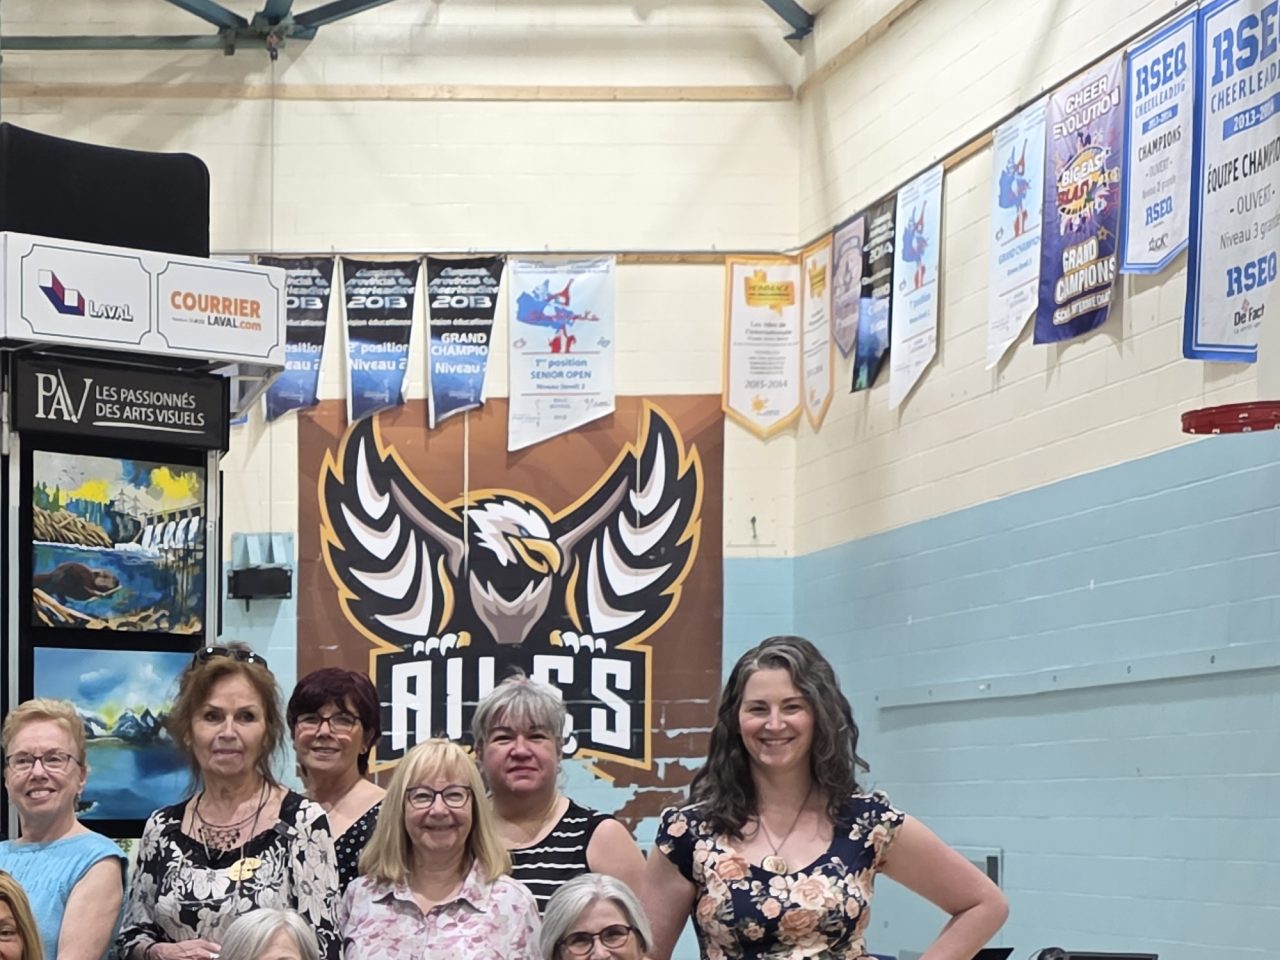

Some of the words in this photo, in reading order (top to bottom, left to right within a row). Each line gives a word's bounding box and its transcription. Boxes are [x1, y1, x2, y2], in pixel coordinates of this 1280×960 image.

[1212, 0, 1280, 87] RSE
[1136, 41, 1187, 101] RSEQ
[1065, 75, 1108, 114] CHEER
[1138, 125, 1182, 162] CHAMPIONS
[1208, 157, 1239, 195] ÉQUIPE
[1242, 136, 1280, 178] CHAMPIO
[1237, 184, 1272, 215] OUVERT
[1146, 196, 1173, 226] RSEQ
[1226, 251, 1277, 298] RSEQ
[89, 300, 134, 322] LAVAL
[170, 290, 262, 318] COURRIER
[286, 297, 323, 309] 013
[347, 296, 408, 309] 2013
[431, 295, 492, 308] 2013
[207, 315, 262, 331] LAVAL.com
[1234, 311, 1247, 327] De
[286, 342, 322, 353] ositio
[441, 332, 487, 344] GRAND
[431, 345, 489, 356] CHAMPIO
[351, 358, 396, 371] Niveau
[435, 362, 480, 374] Niveau
[548, 359, 588, 369] position
[531, 371, 565, 380] SENIOR
[566, 370, 592, 379] OPEN
[95, 385, 118, 401] LES
[120, 388, 196, 410] PASSIONNÉS
[95, 402, 120, 419] DES
[122, 406, 154, 422] ARTS
[155, 409, 205, 427] VISUELS
